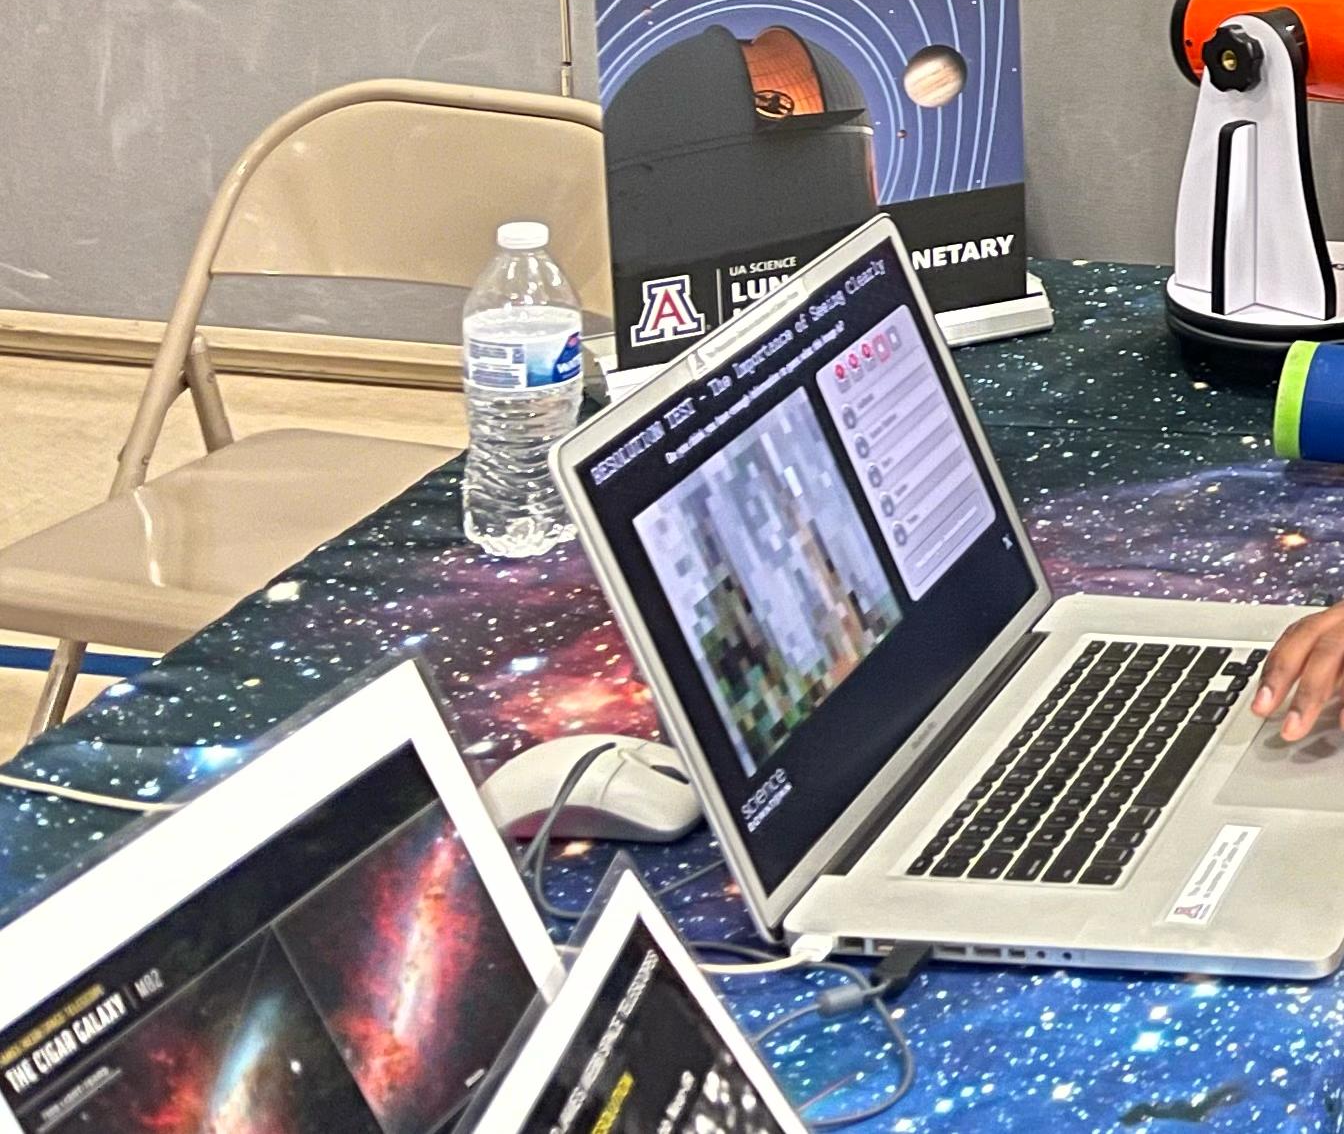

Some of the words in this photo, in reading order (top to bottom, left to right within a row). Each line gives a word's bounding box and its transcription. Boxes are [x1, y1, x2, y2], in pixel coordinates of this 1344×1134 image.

[729, 265, 747, 277] UA
[749, 256, 797, 274] SCIENCE
[5, 1058, 38, 1094] THE
[32, 1029, 78, 1074] CIGAR
[72, 993, 127, 1044] GALAXY
